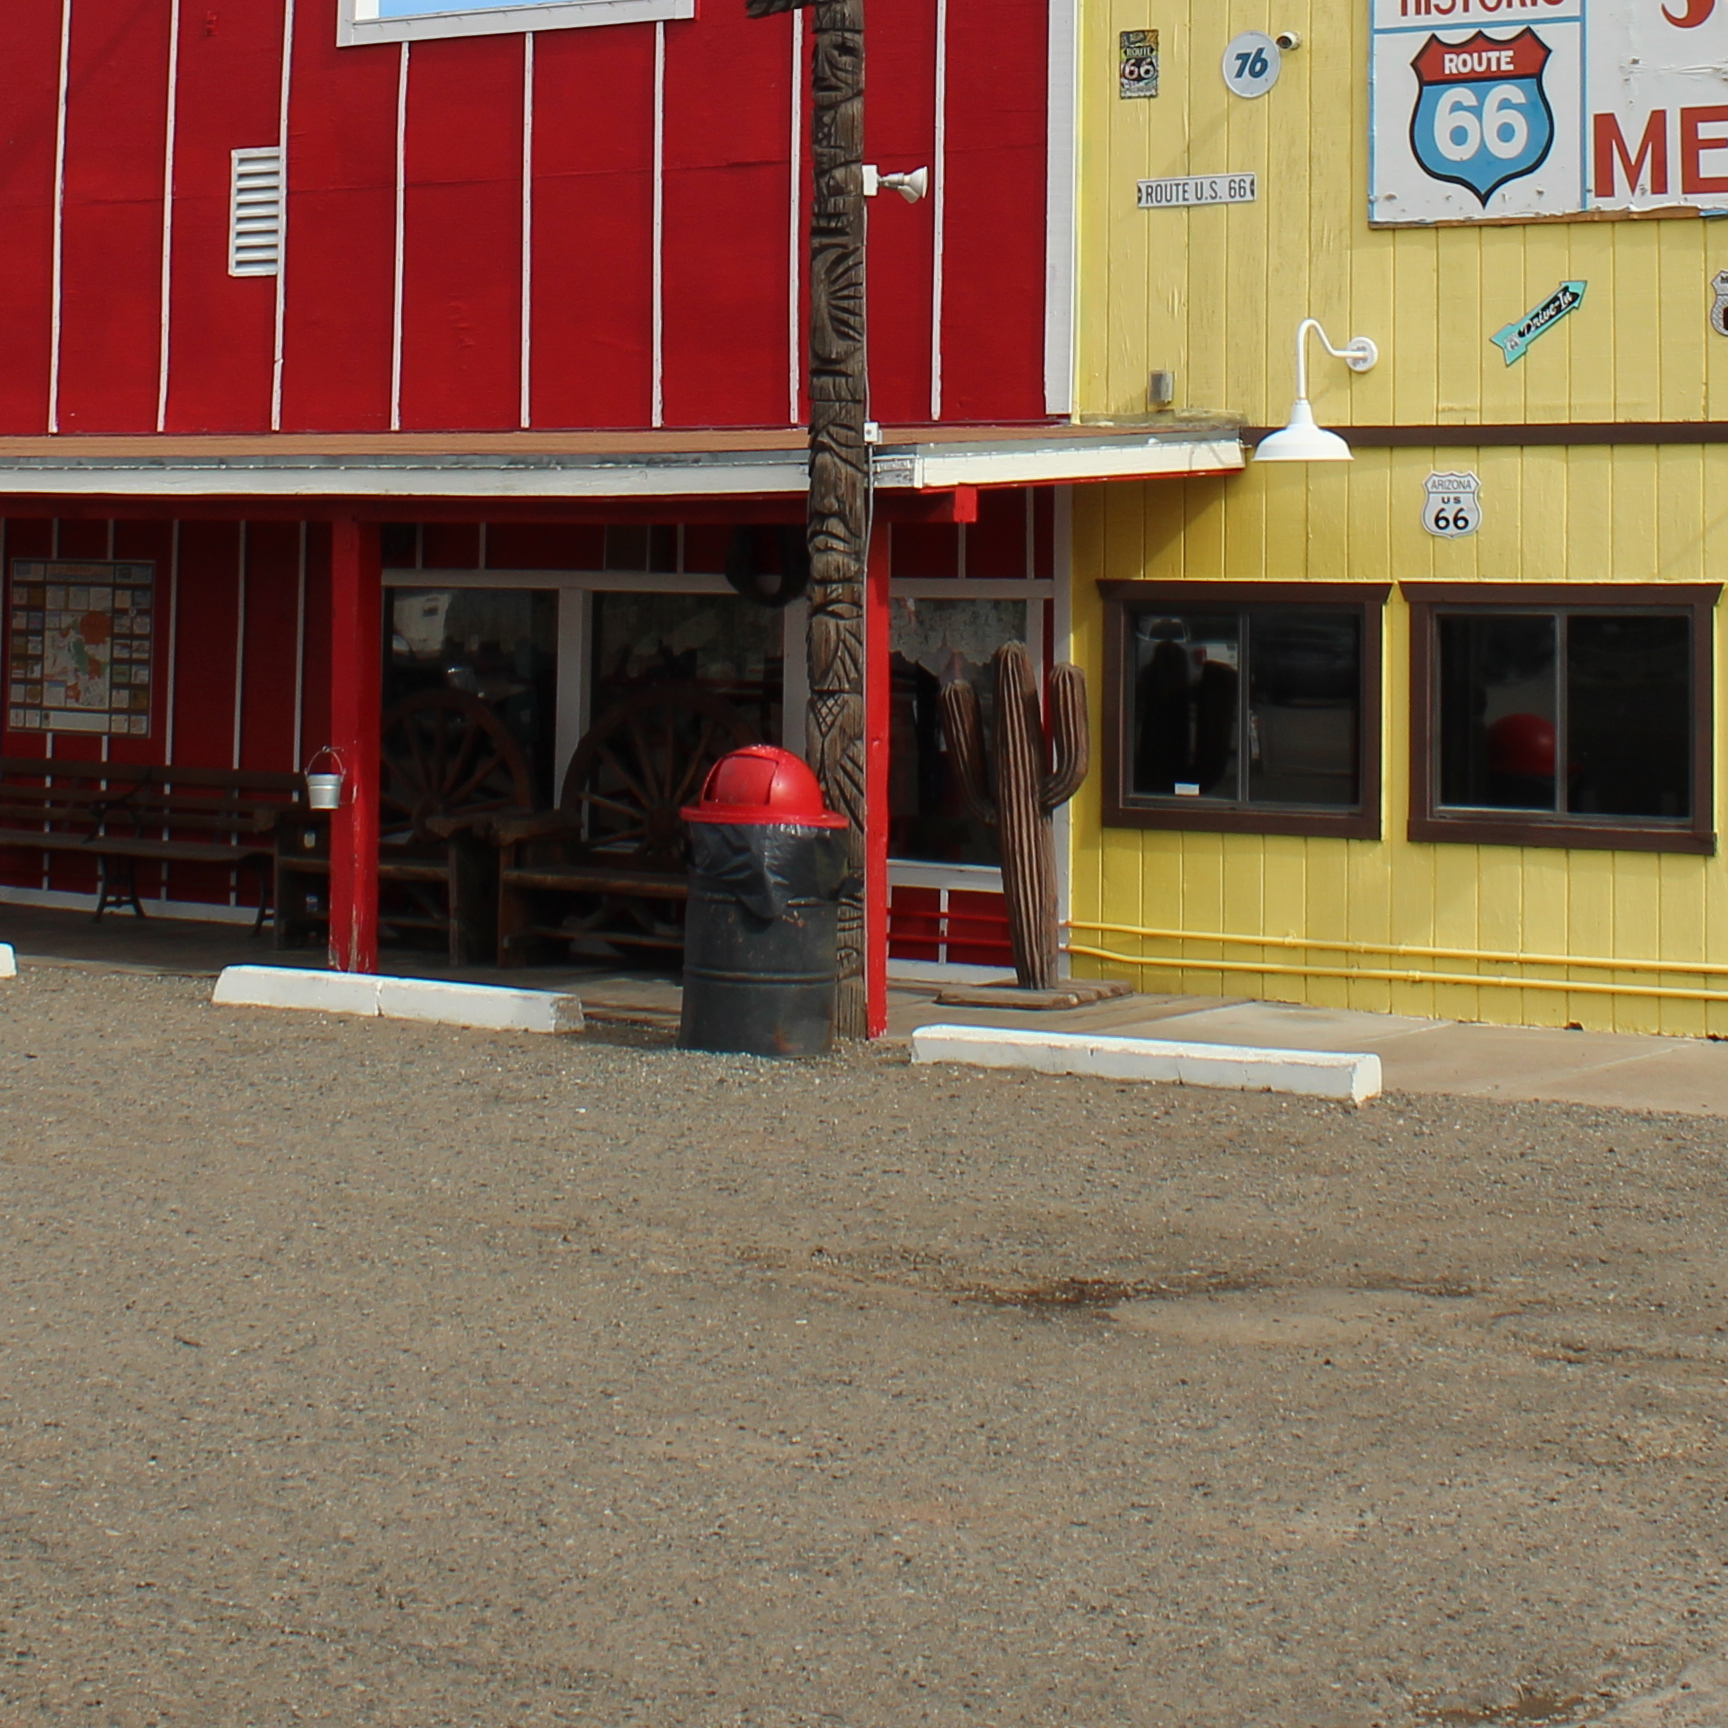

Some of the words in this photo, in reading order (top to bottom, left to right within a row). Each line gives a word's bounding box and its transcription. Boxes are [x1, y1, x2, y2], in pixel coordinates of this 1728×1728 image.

[1127, 46, 1153, 57] ROUTE
[1233, 47, 1269, 80] 76
[1443, 48, 1515, 75] ROUTE
[1124, 58, 1157, 80] 66
[1432, 83, 1528, 161] 66
[1145, 182, 1189, 204] ROUTE
[1194, 180, 1223, 201] U.S.
[1228, 178, 1247, 199] 66
[1520, 288, 1574, 336] Drive-In
[1430, 479, 1472, 490] ARIZONA
[1434, 507, 1470, 530] 66
